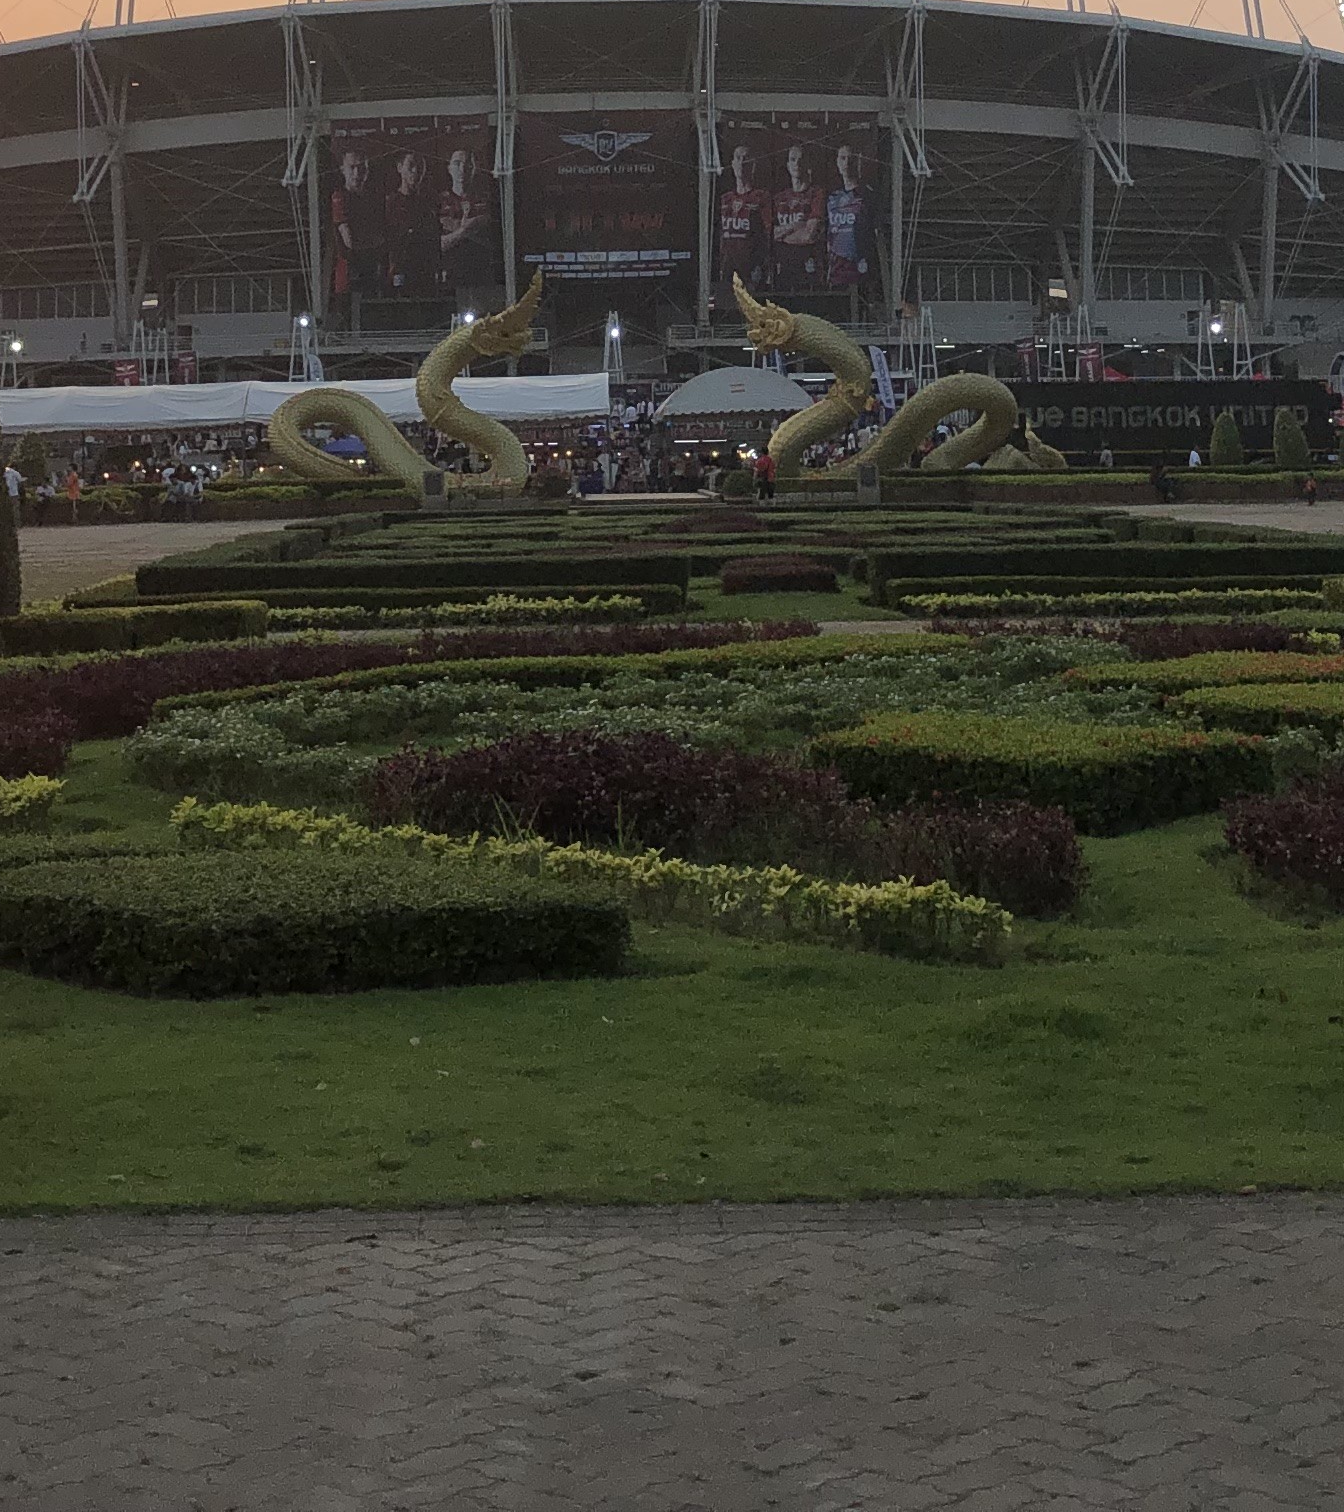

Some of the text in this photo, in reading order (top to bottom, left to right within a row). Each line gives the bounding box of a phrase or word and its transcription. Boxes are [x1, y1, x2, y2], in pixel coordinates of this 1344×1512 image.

[557, 163, 656, 175] BANGKOK UNITED
[721, 215, 750, 231] true
[777, 211, 805, 226] true
[828, 211, 856, 225] true
[1014, 405, 1064, 428] rue
[1071, 405, 1201, 428] BANGKOK
[1208, 404, 1309, 426] UNITD
